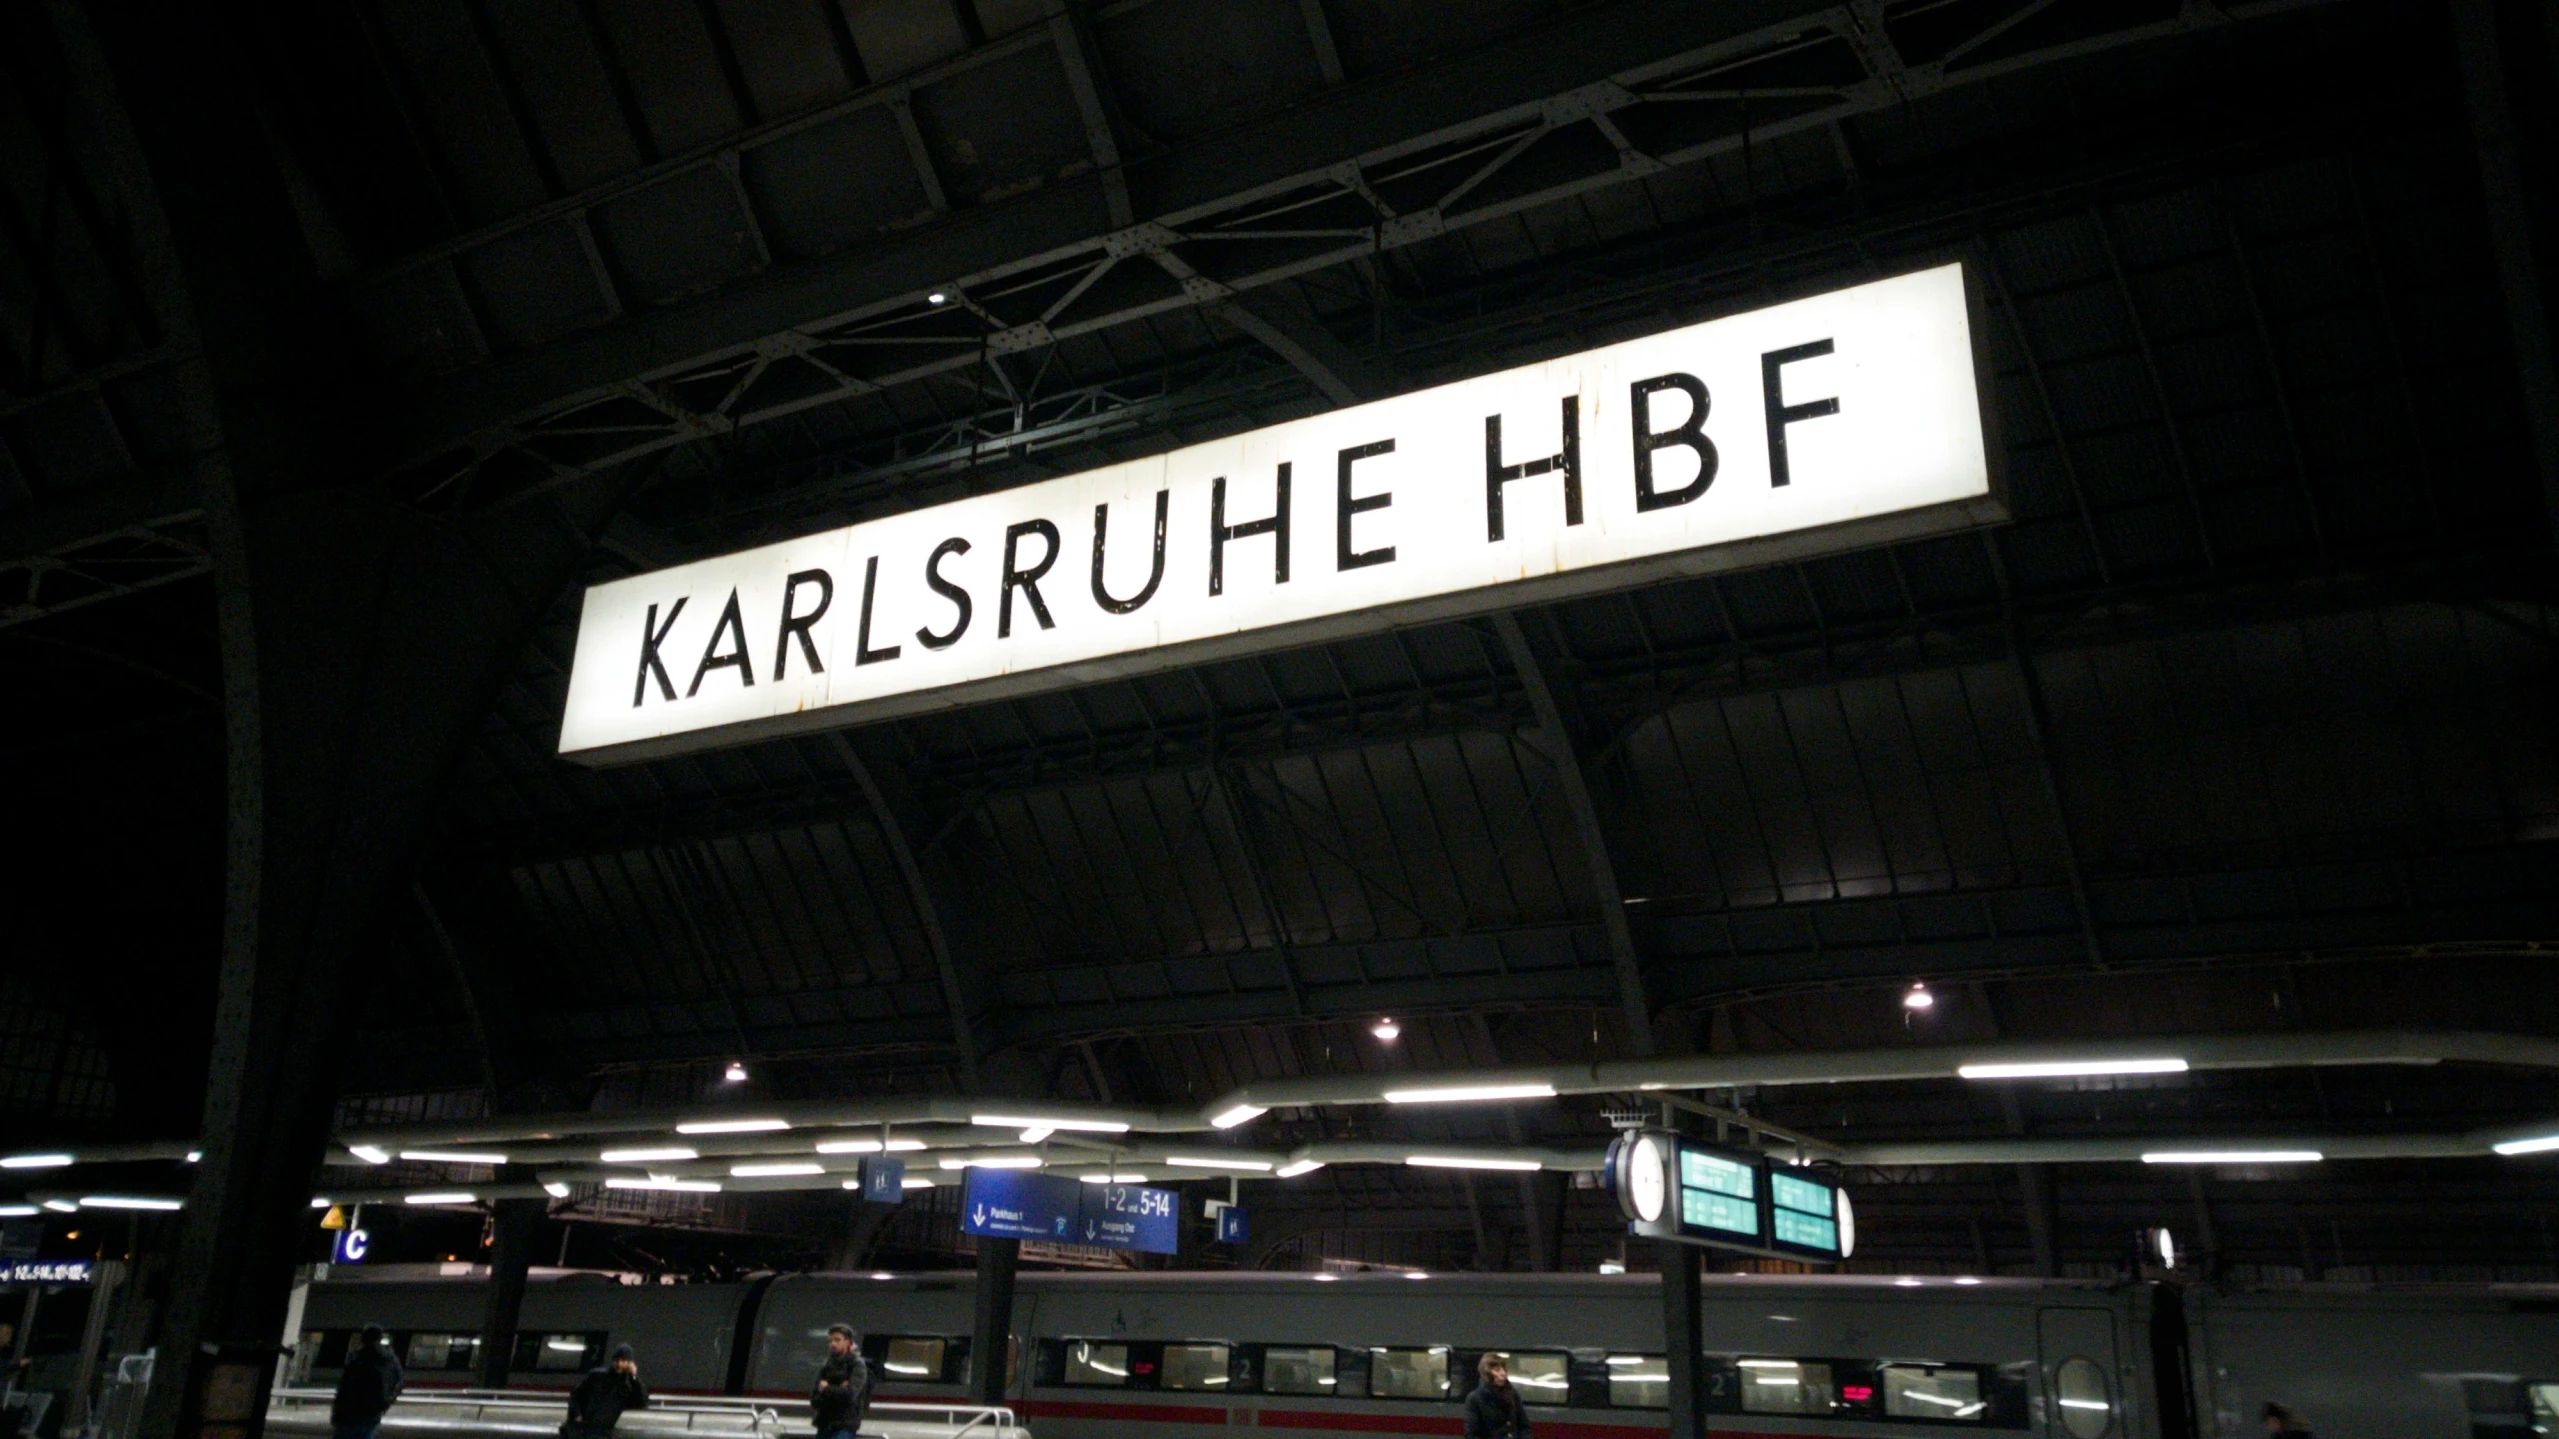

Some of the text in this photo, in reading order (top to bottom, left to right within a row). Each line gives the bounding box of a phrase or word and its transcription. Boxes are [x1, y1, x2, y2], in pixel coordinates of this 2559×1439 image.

[630, 336, 1842, 709] KARLSRUHE HBF
[1104, 1187, 1126, 1211] 1-2
[1140, 1190, 1170, 1217] 5-14
[346, 1229, 367, 1260] C
